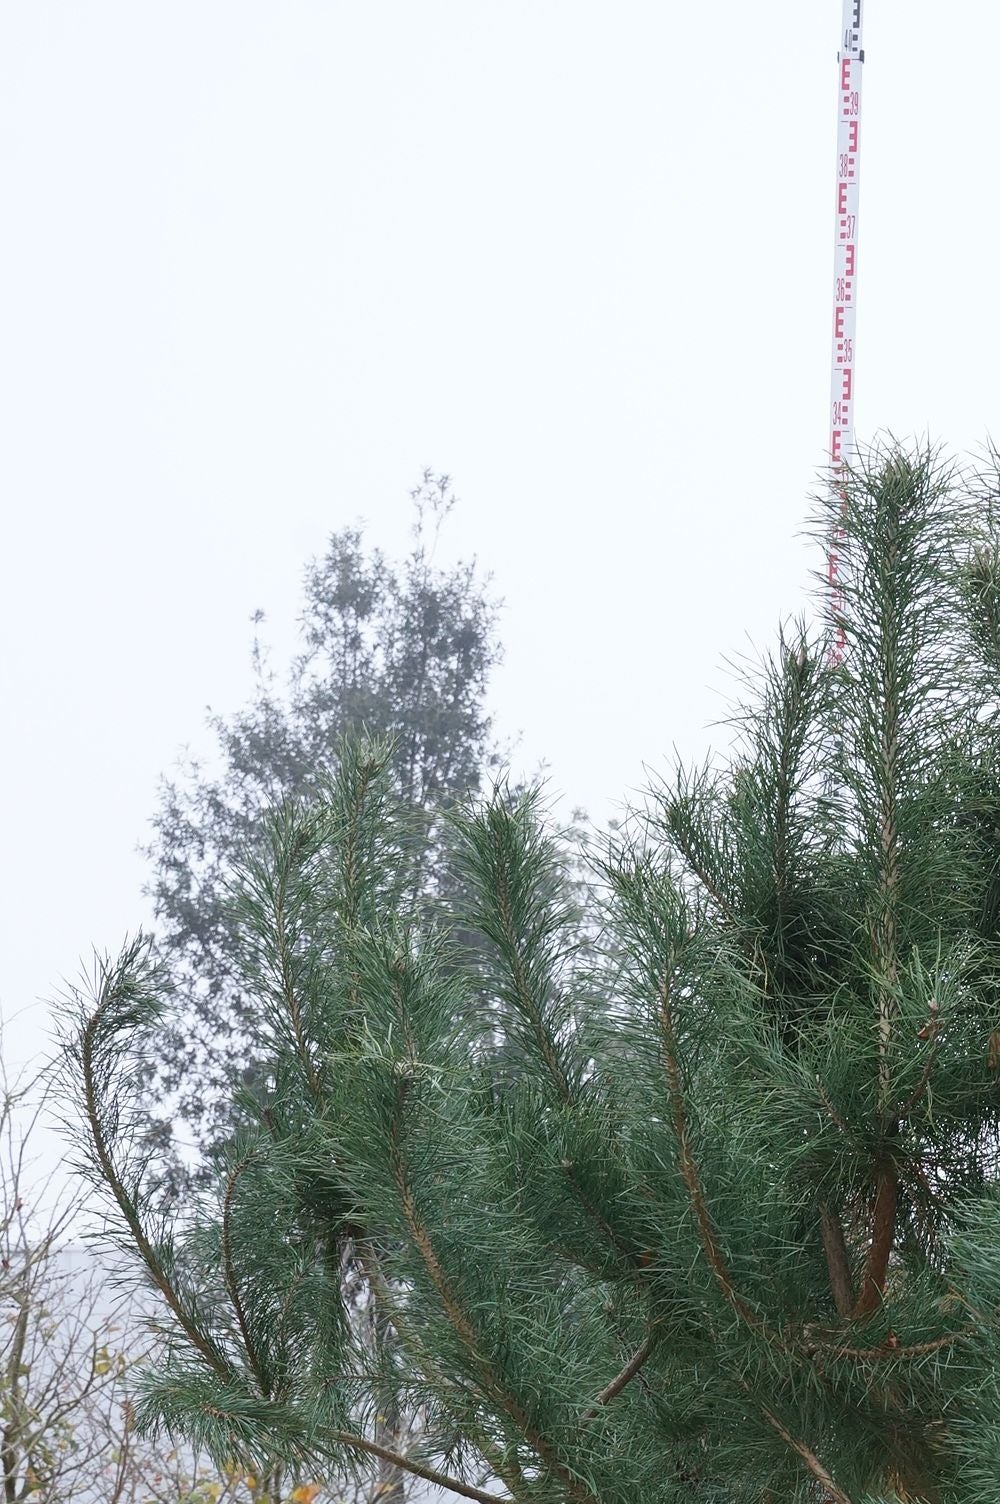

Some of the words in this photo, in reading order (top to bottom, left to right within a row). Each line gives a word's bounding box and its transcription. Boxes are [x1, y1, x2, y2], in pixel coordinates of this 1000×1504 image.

[849, 91, 859, 116] 39
[839, 153, 848, 178] 38
[846, 215, 856, 239] 37
[835, 278, 845, 302] 36
[843, 338, 853, 363] 35
[832, 401, 842, 425] 34
